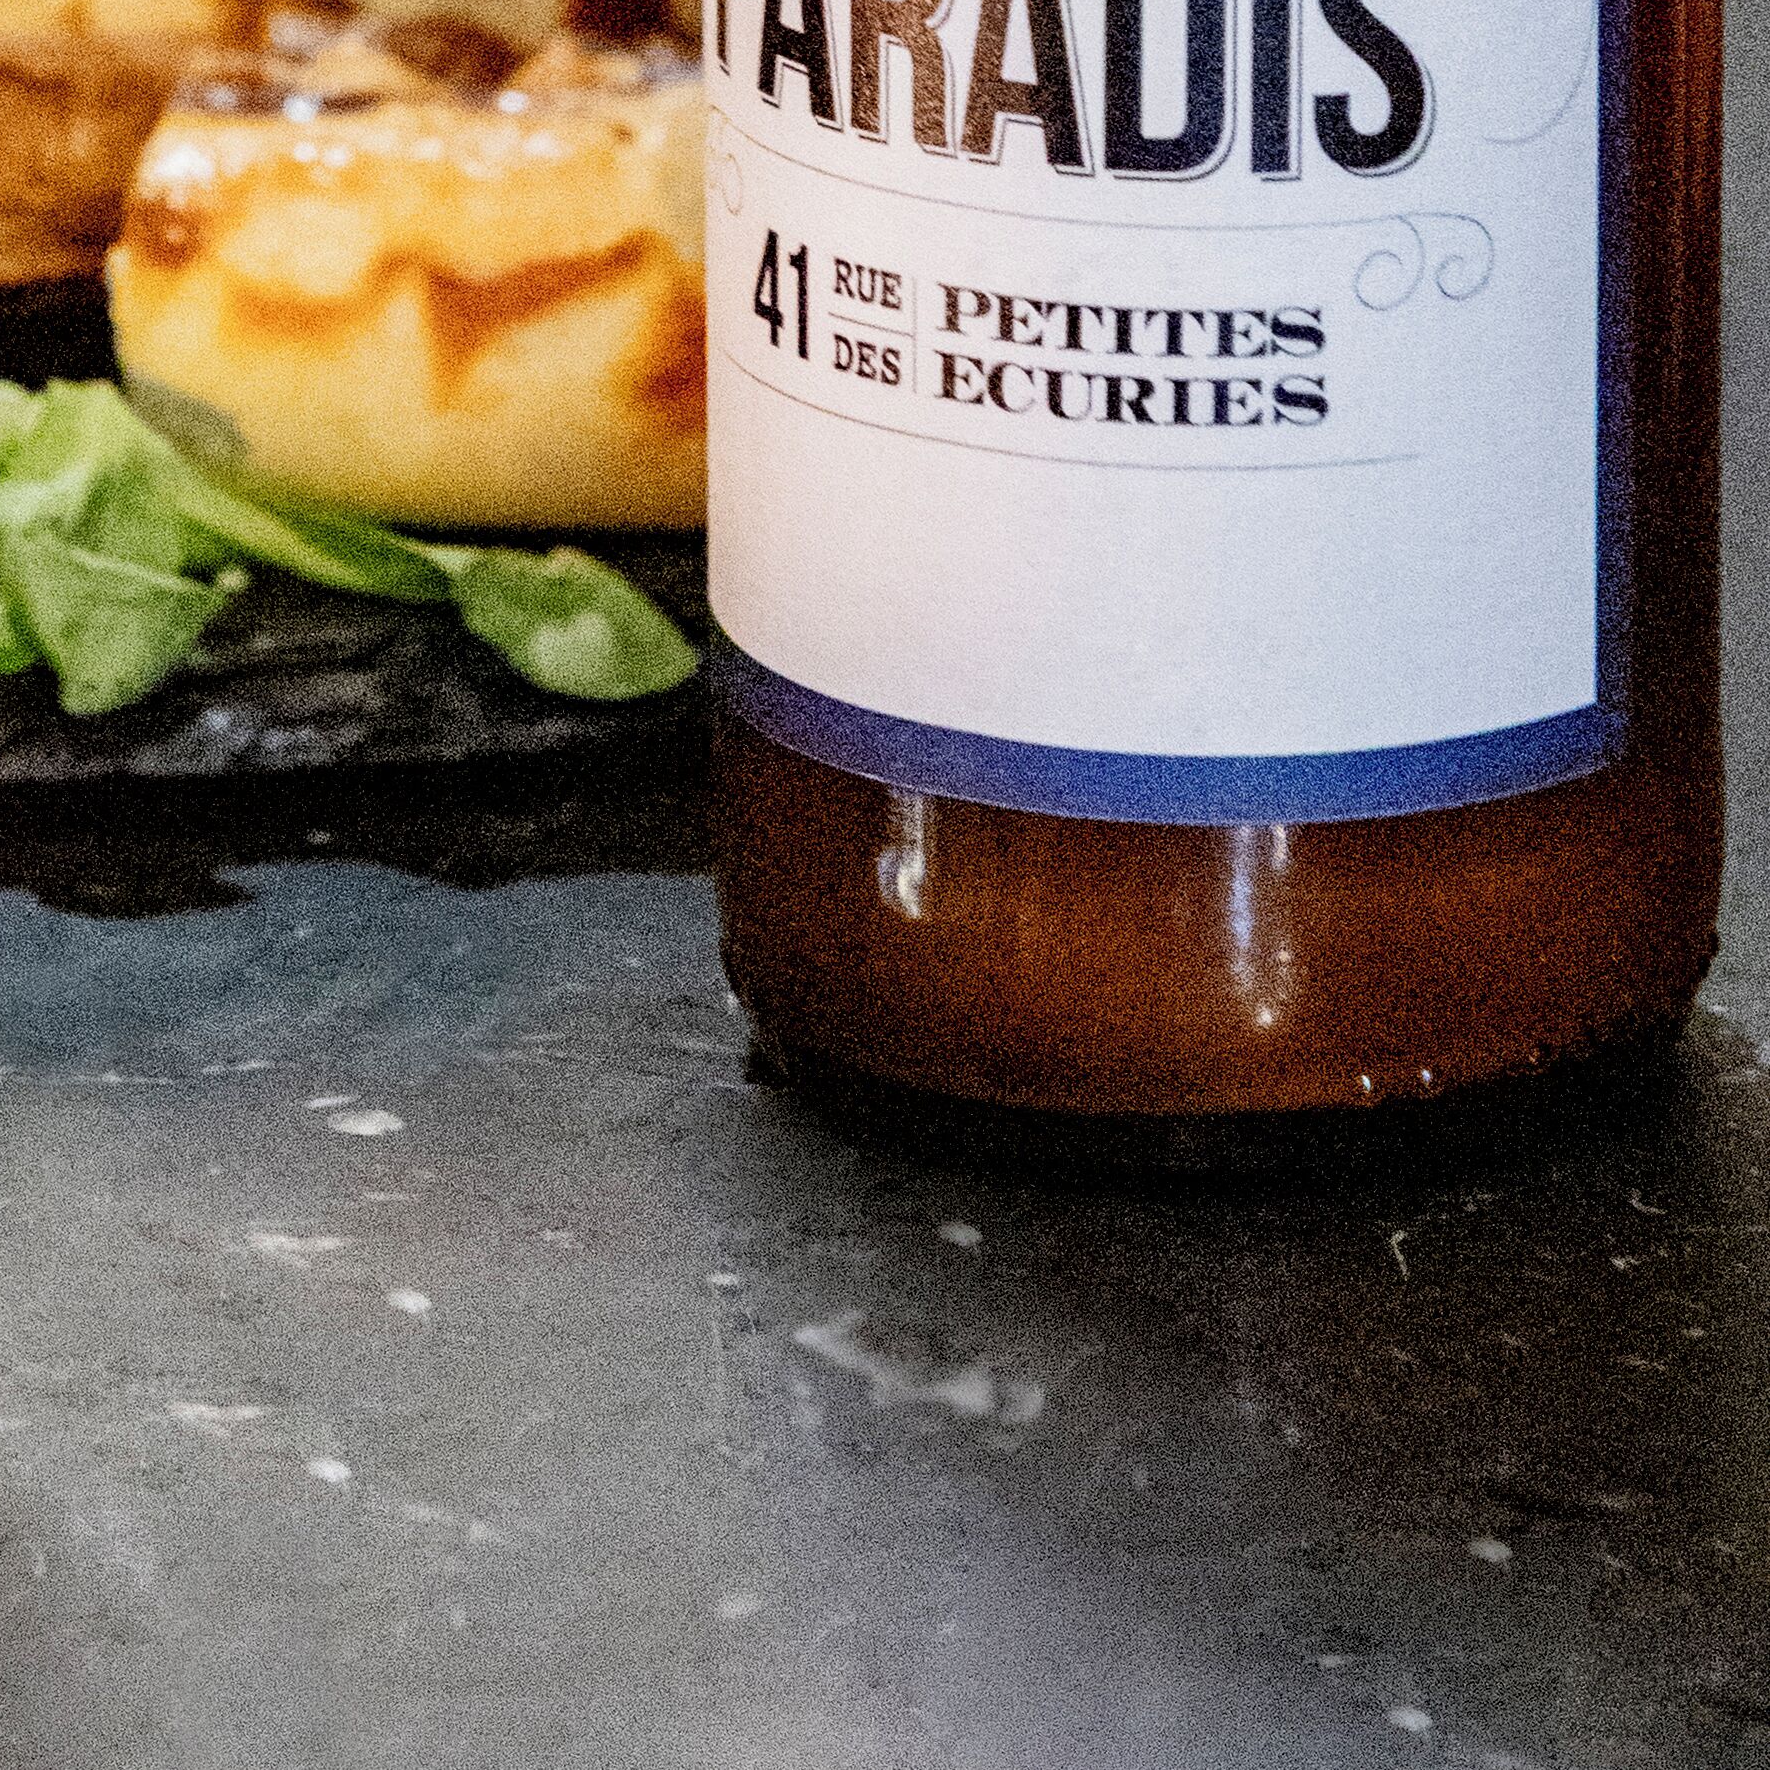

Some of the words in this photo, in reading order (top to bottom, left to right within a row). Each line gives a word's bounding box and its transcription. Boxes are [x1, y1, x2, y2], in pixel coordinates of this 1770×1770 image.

[752, 228, 812, 360] 41
[832, 256, 904, 310] RUE
[937, 281, 1326, 359] PETITES
[832, 335, 903, 387] DES
[937, 347, 1329, 428] ECURIES
